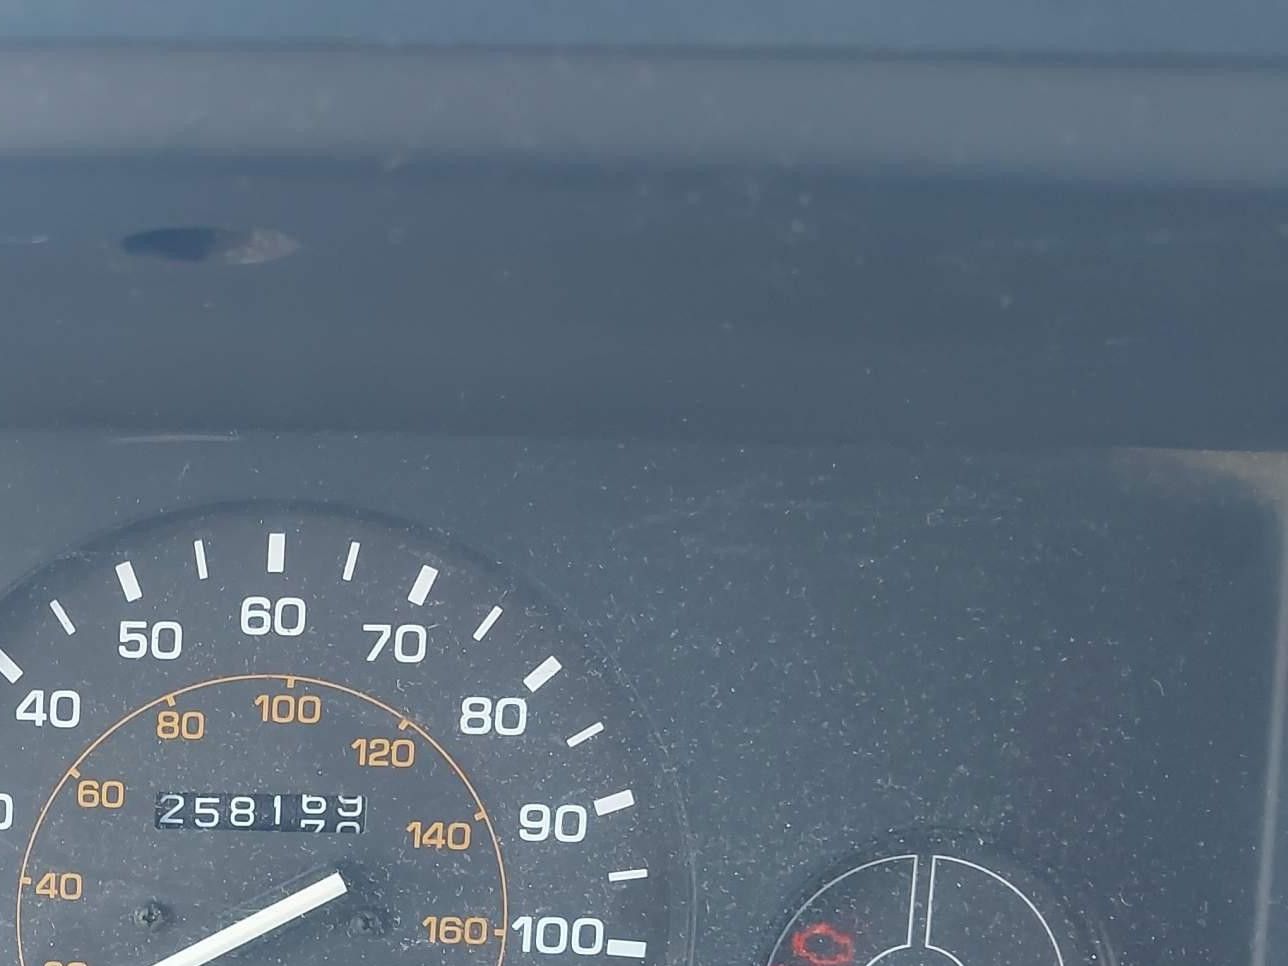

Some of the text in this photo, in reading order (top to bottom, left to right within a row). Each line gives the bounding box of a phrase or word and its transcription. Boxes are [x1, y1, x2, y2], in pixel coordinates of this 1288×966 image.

[240, 596, 307, 636] 60
[118, 620, 183, 660] 50
[362, 624, 428, 663] 70
[15, 689, 81, 728] 40
[255, 695, 322, 724] 100
[459, 696, 528, 736] 80
[157, 711, 204, 740] 80
[353, 739, 414, 767] 120
[77, 780, 125, 808] 60
[408, 821, 470, 849] 140
[519, 803, 587, 843] 90
[36, 873, 82, 897] 40
[424, 916, 488, 945] 160
[513, 917, 605, 955] 100
